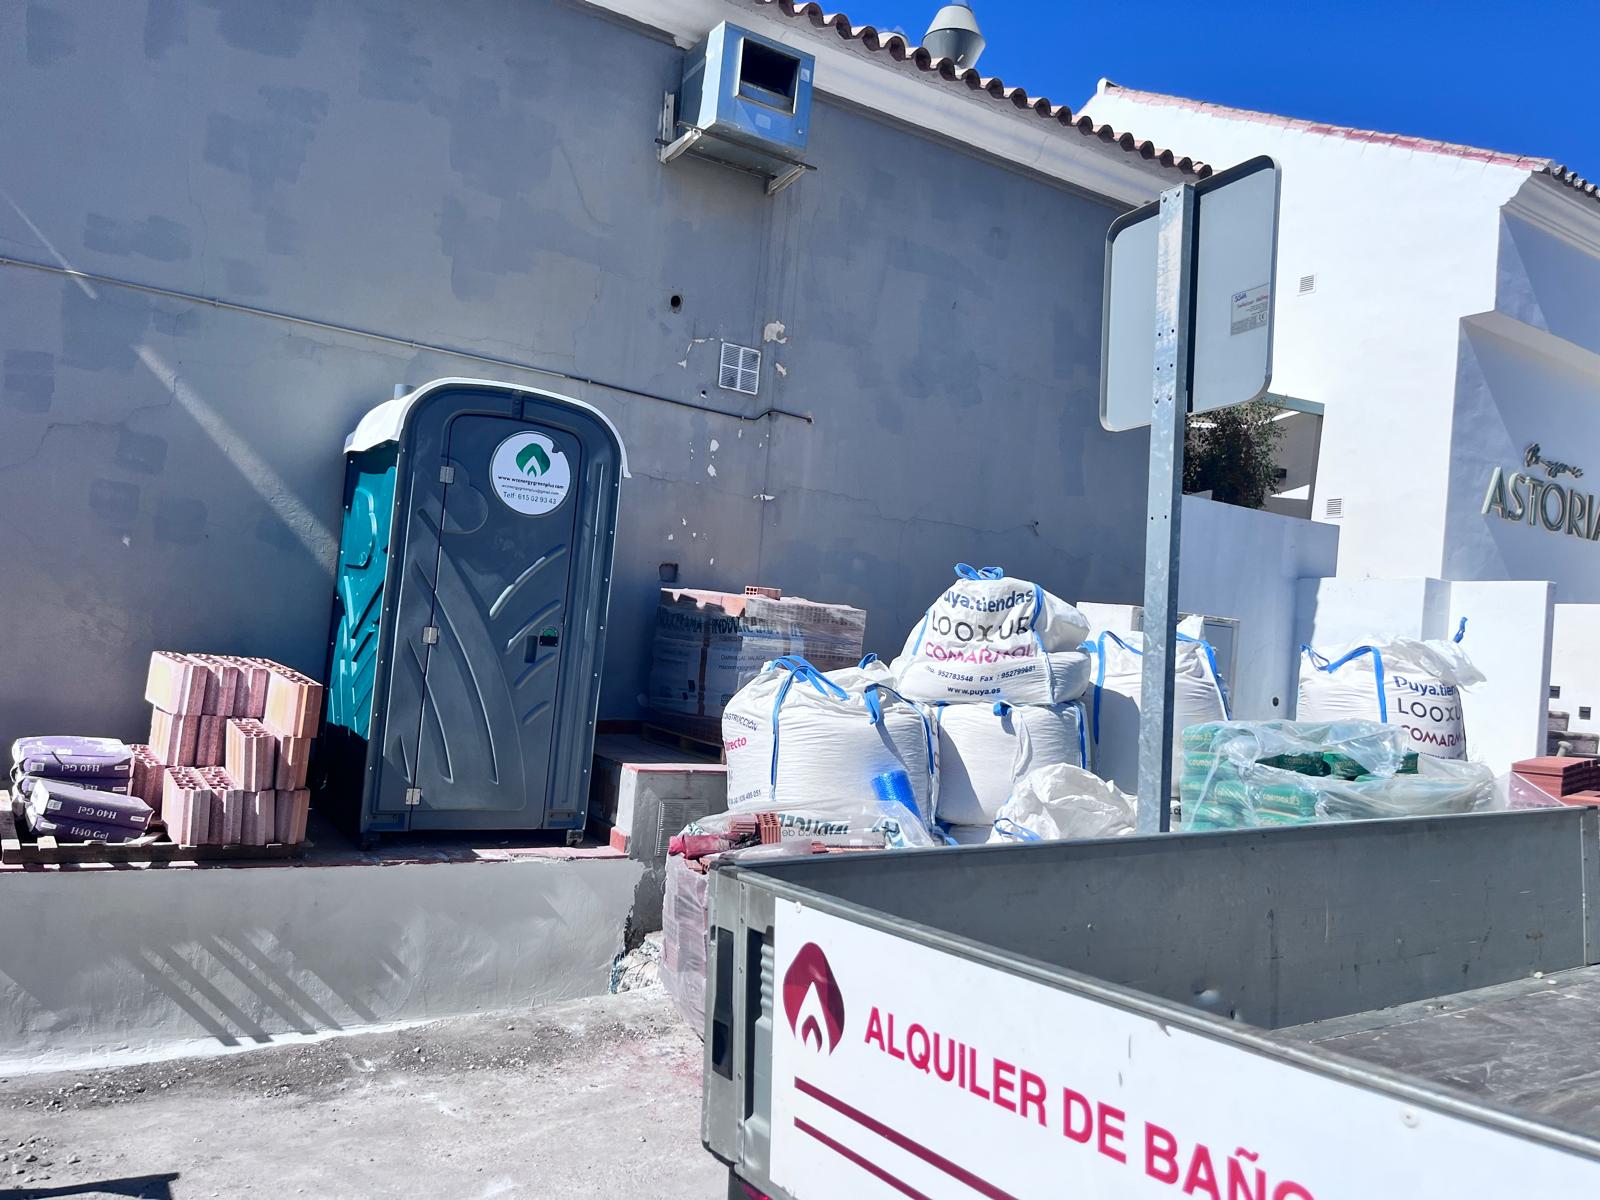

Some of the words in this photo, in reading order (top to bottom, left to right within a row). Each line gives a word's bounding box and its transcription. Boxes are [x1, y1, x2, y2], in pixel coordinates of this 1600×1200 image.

[943, 590, 1034, 613] uya.tiendas
[980, 675, 994, 683] Fax
[78, 806, 94, 815] Gel
[96, 809, 117, 819] H40
[70, 826, 91, 837] H40
[93, 830, 109, 840] Gel
[864, 1006, 1047, 1127] ALQUILER
[1063, 1086, 1127, 1164] DE
